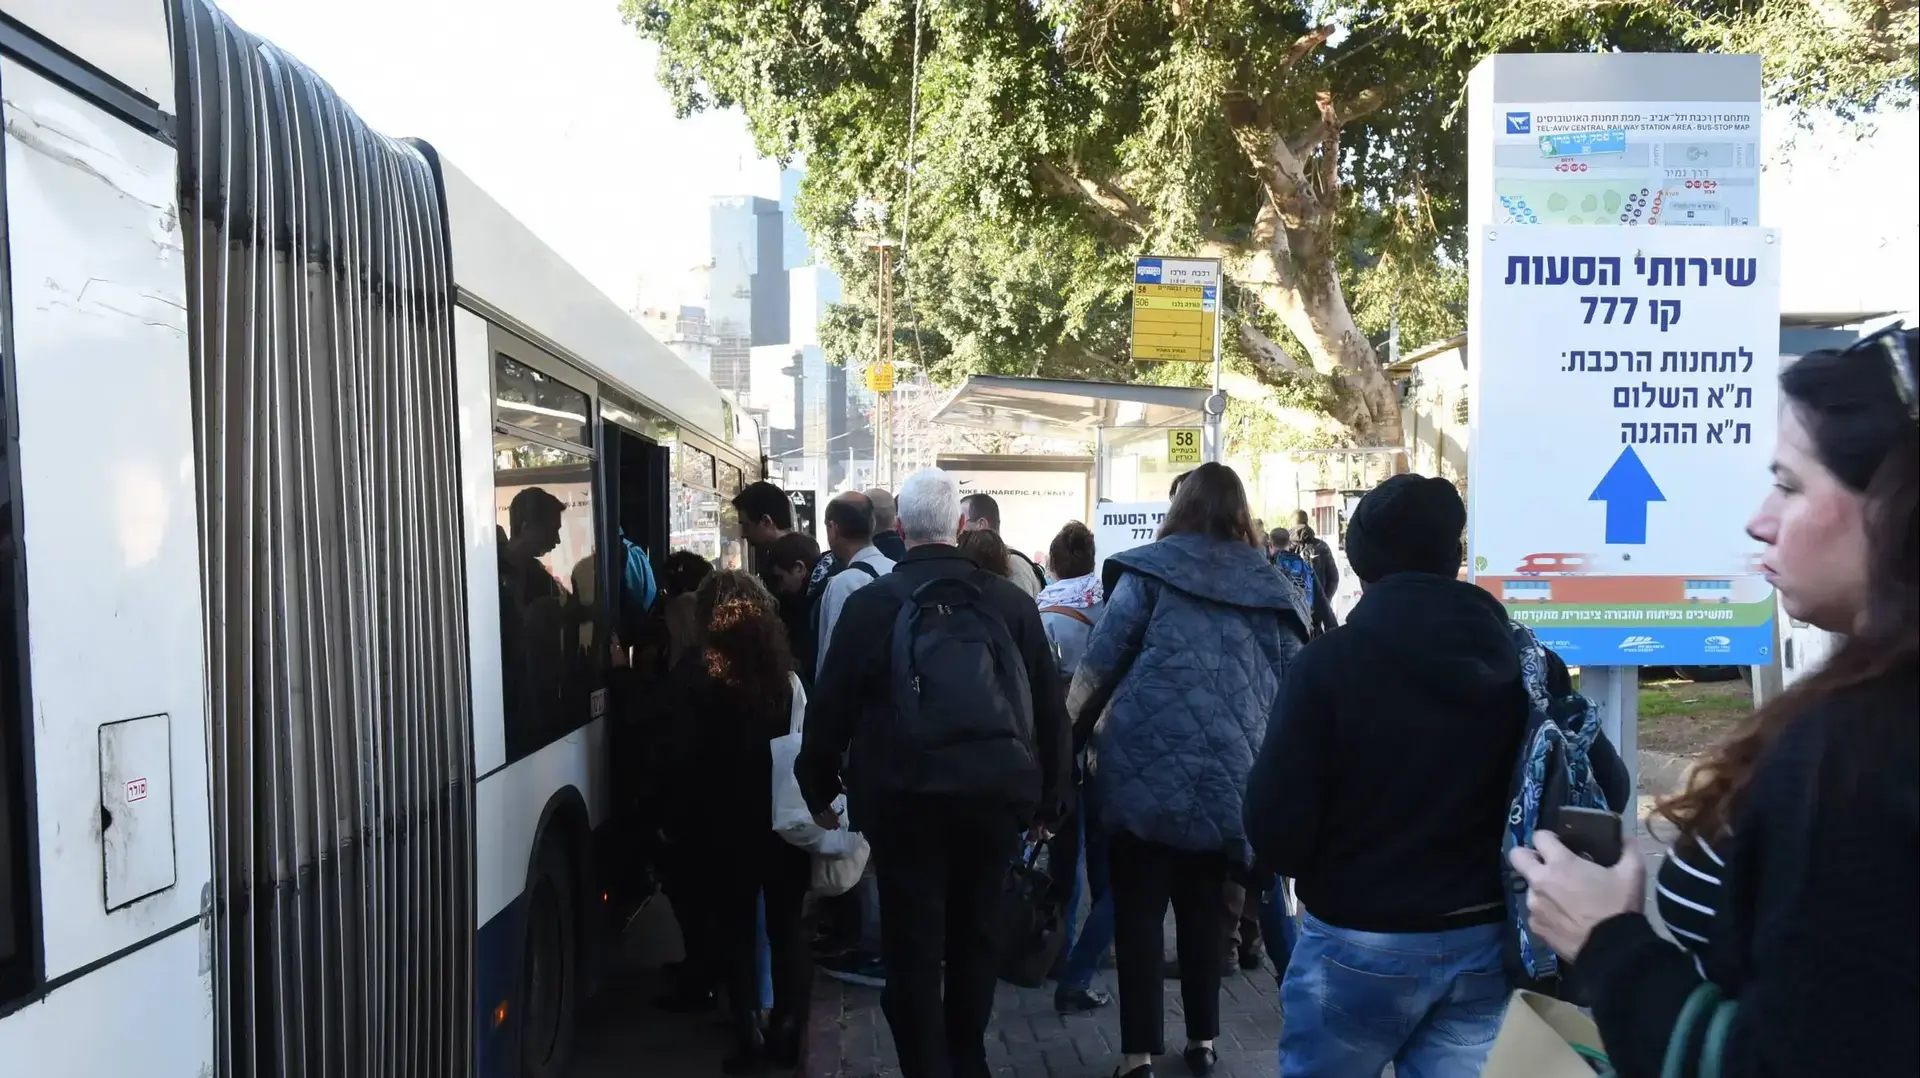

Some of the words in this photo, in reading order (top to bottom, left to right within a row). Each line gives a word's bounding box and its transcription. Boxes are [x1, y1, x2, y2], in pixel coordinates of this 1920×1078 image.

[1536, 114, 1588, 124] האוטובוסים
[1590, 114, 1619, 123] תחנות
[1620, 114, 1641, 122] מפת
[1688, 114, 1712, 122] רכבת
[1723, 114, 1750, 122] מתחם
[1640, 123, 1671, 131] STATION
[1671, 123, 1692, 131] AREA
[1696, 123, 1734, 131] BUS-STOP
[1734, 123, 1750, 131] MAP
[1664, 169, 1687, 177] נמיר
[1691, 169, 1709, 179] דרך
[1504, 255, 1621, 286] הסעות
[1634, 256, 1757, 288] שירותי
[1137, 285, 1147, 294] 58
[1135, 298, 1150, 307] 506
[1580, 296, 1639, 325] 777
[1648, 299, 1682, 333] קו
[1561, 350, 1652, 373] הרכבת:
[1660, 346, 1754, 373] לתחנות
[1613, 381, 1699, 409] השלום
[1620, 422, 1698, 444] ההגנה
[1175, 432, 1194, 446] 58
[1102, 513, 1147, 526] הסעות
[1131, 528, 1154, 540] 777
[1512, 610, 1559, 622] מתקדמת
[1561, 610, 1602, 620] ציבורית
[1604, 610, 1644, 620] תחבורה
[1645, 609, 1684, 620] בפיתוח
[1685, 609, 1734, 620] ממשיכים
[128, 783, 146, 797] סולר
